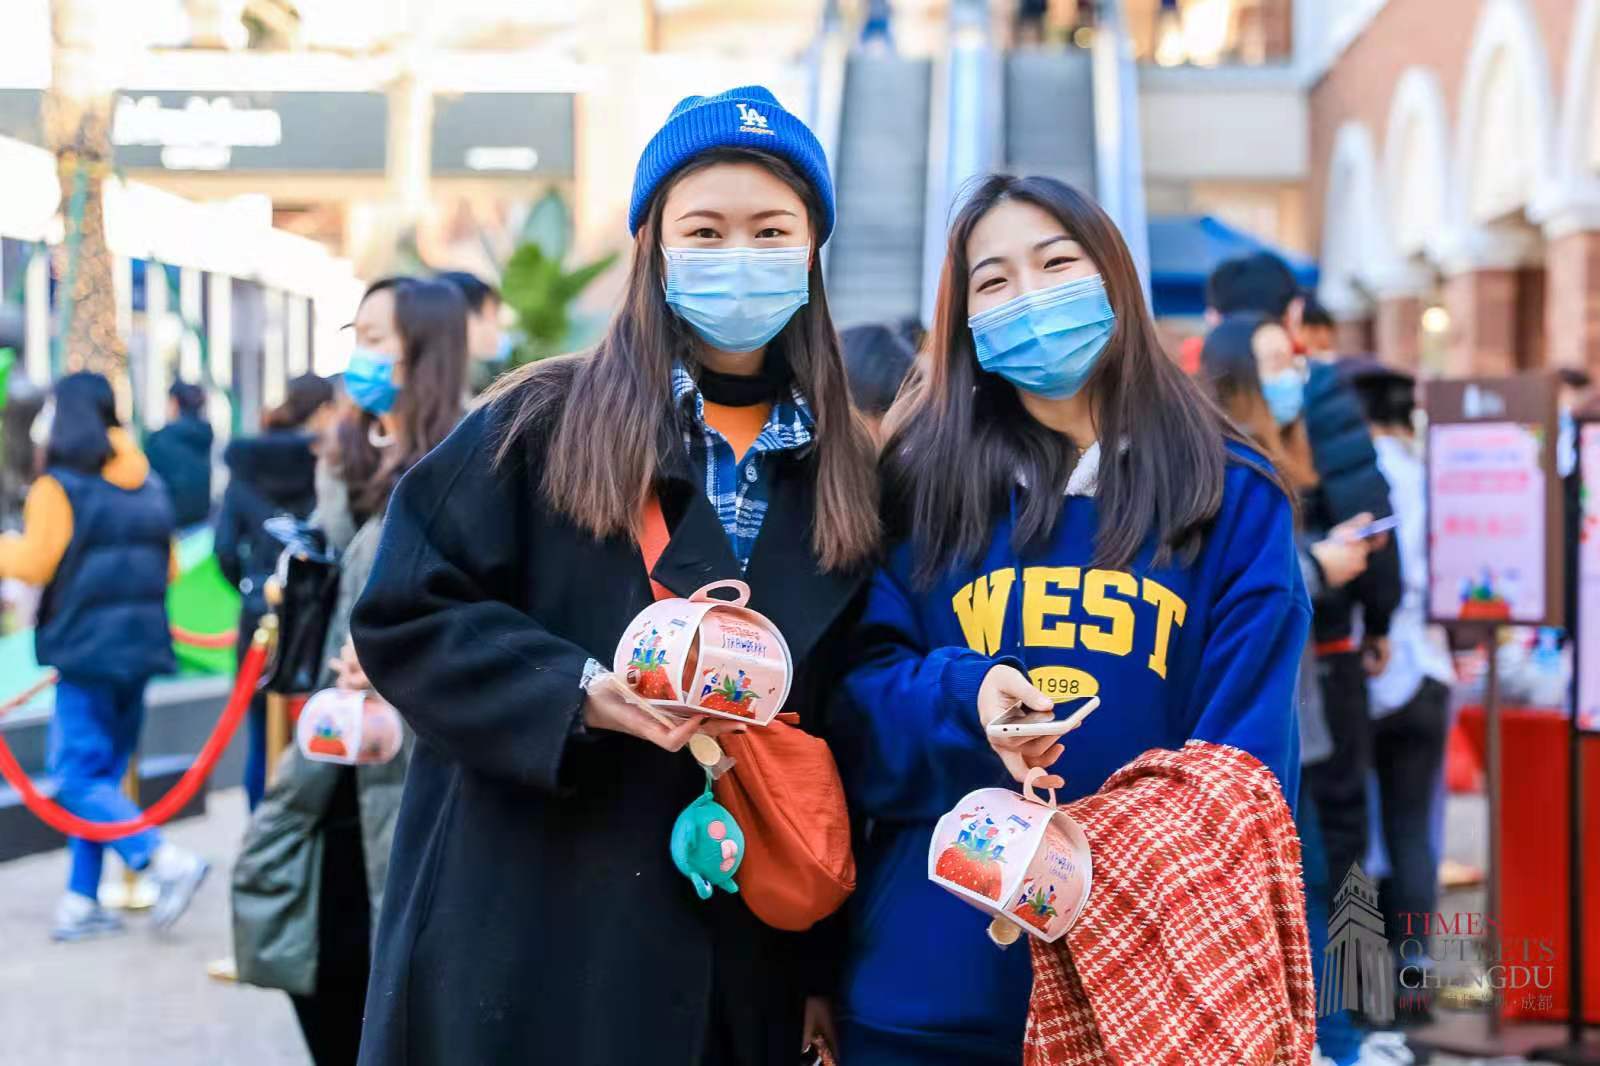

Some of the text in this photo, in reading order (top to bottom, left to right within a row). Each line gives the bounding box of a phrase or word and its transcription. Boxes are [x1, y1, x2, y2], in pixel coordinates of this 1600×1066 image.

[736, 103, 768, 127] LA
[952, 566, 1187, 680] WEST
[1037, 678, 1080, 694] 1998
